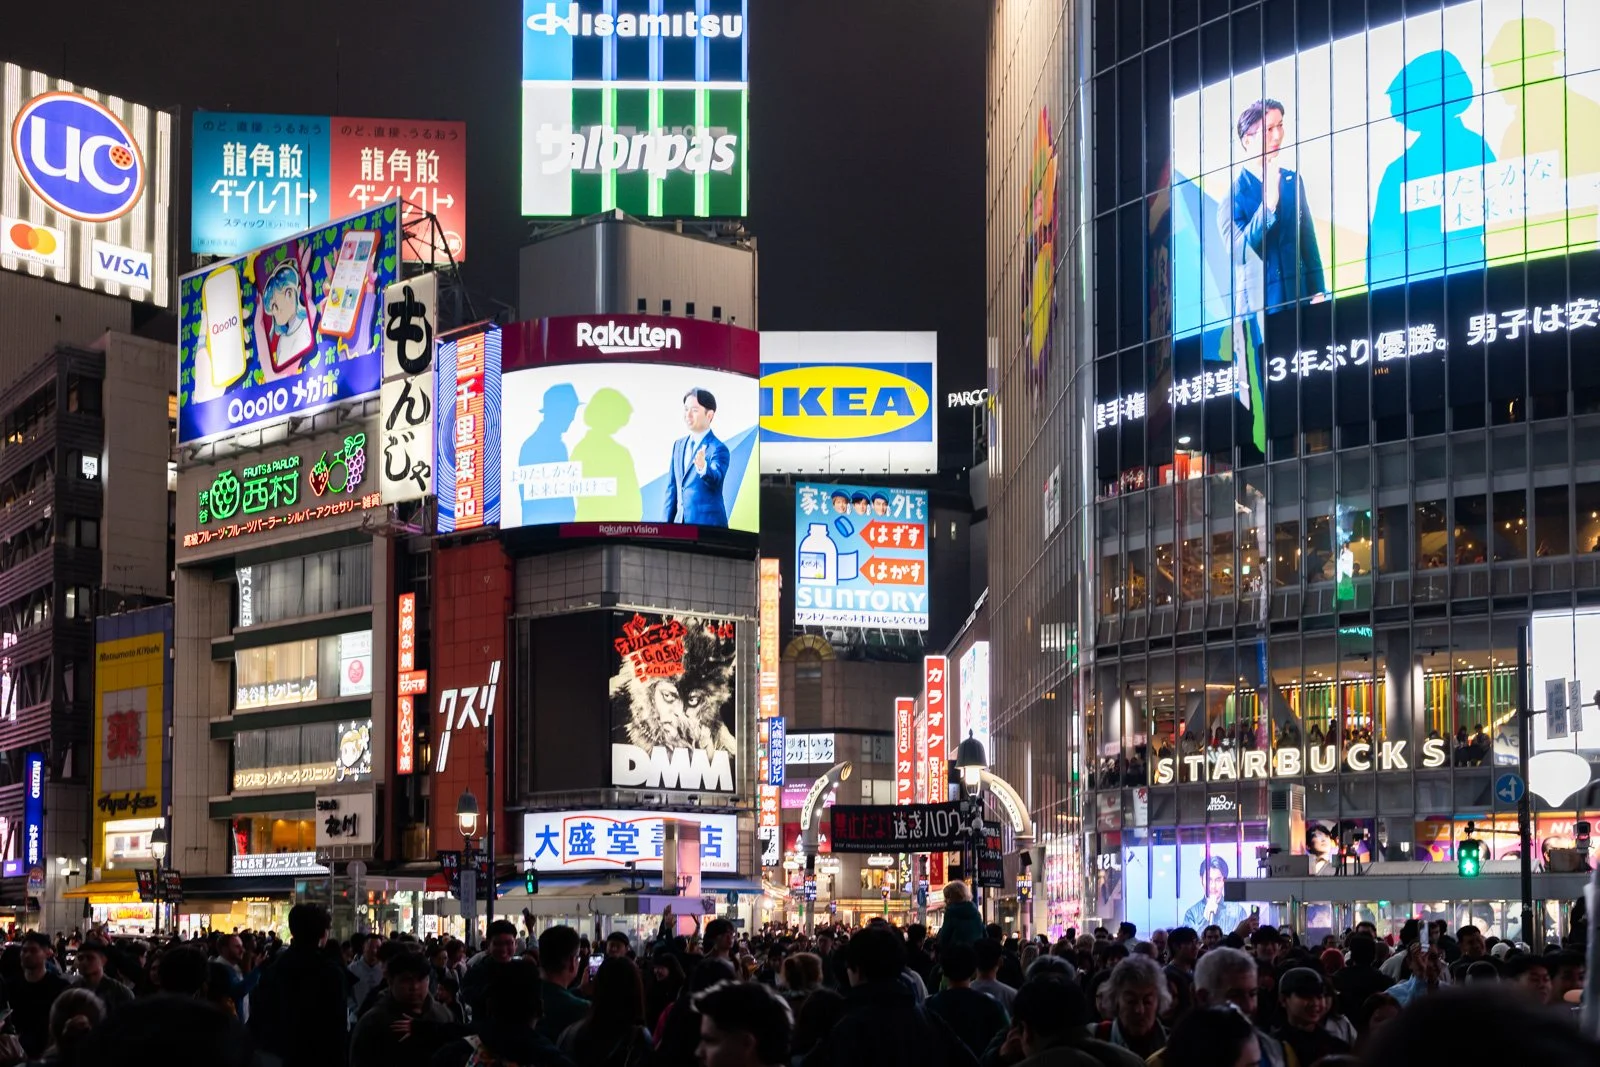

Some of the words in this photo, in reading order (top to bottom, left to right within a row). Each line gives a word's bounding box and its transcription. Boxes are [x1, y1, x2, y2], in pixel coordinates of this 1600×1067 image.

[527, 3, 743, 37] Hisamitsu
[30, 115, 131, 195] UC
[223, 141, 303, 178] 龍角散
[361, 147, 439, 183] 龍角散
[210, 179, 317, 215] ダイレクト
[98, 251, 149, 279] VISA
[212, 316, 238, 335] Qoo10
[576, 321, 682, 350] Rakuten
[1467, 297, 1600, 346] 男子は安
[227, 386, 288, 424] Qoo10
[294, 371, 339, 407] メガポ
[386, 285, 432, 492] もんじゃ
[760, 387, 916, 416] IKEA
[454, 341, 477, 517] 三千里薬品
[243, 464, 266, 478] FRUITS
[273, 456, 300, 472] PARLOR
[243, 470, 299, 514] 西村
[599, 525, 632, 536] Rakuten
[634, 525, 659, 534] Vision
[869, 525, 920, 546] はずす
[869, 562, 921, 583] はがす
[797, 586, 926, 612] SUNTORY
[928, 667, 944, 749] カラオケ
[612, 743, 733, 791] DMM
[771, 720, 782, 783] 大盛堂商事ビル
[786, 750, 834, 761] クリニック
[1157, 738, 1449, 785] STARBUCKS
[32, 760, 41, 798] MIZUHO
